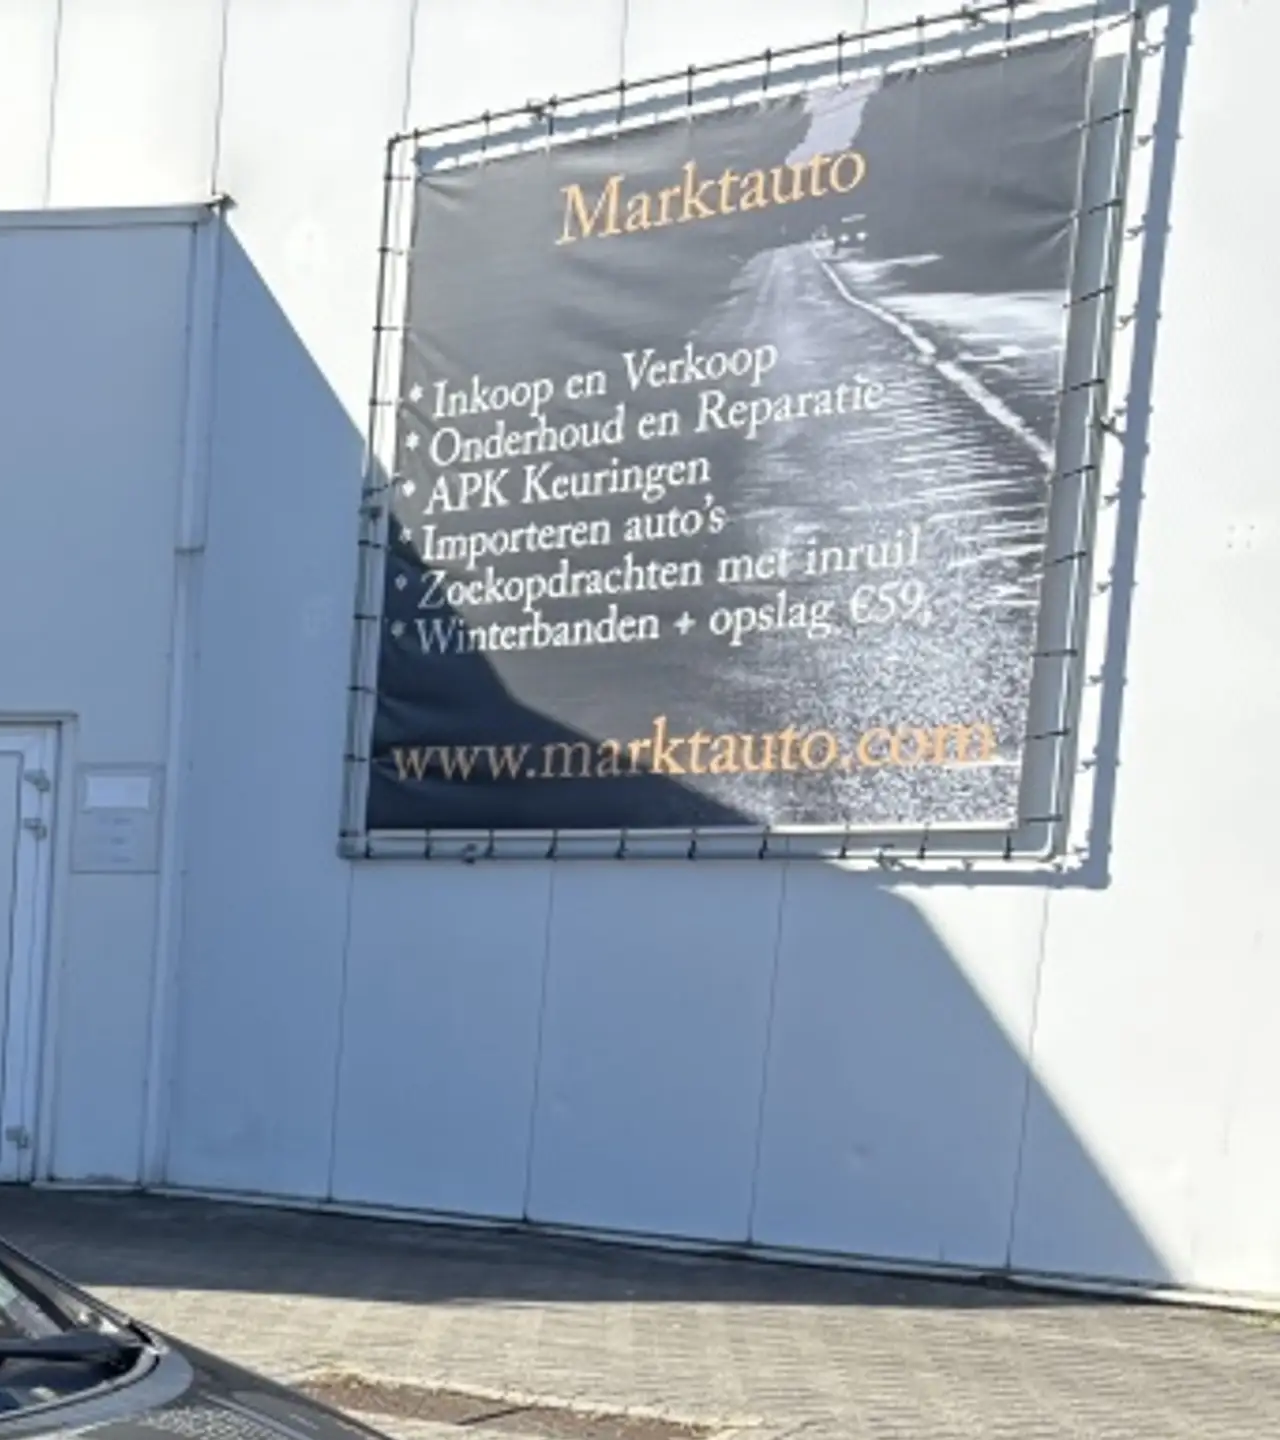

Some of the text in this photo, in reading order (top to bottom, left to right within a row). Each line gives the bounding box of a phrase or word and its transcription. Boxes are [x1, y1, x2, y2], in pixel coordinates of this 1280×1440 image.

[554, 150, 867, 246] Marktauto
[432, 341, 779, 418] Inkoop en Verkoop
[429, 373, 886, 466] Onderhoud en Reparatie
[422, 457, 711, 516] APK Keuringen
[417, 523, 922, 613] Zoekopdrachten met inruil
[421, 493, 727, 571] Importeren auto's
[414, 603, 660, 655] Winterbanden
[673, 611, 697, 636] +
[708, 588, 836, 647] opslag
[392, 715, 996, 783] www.marktauto.com
